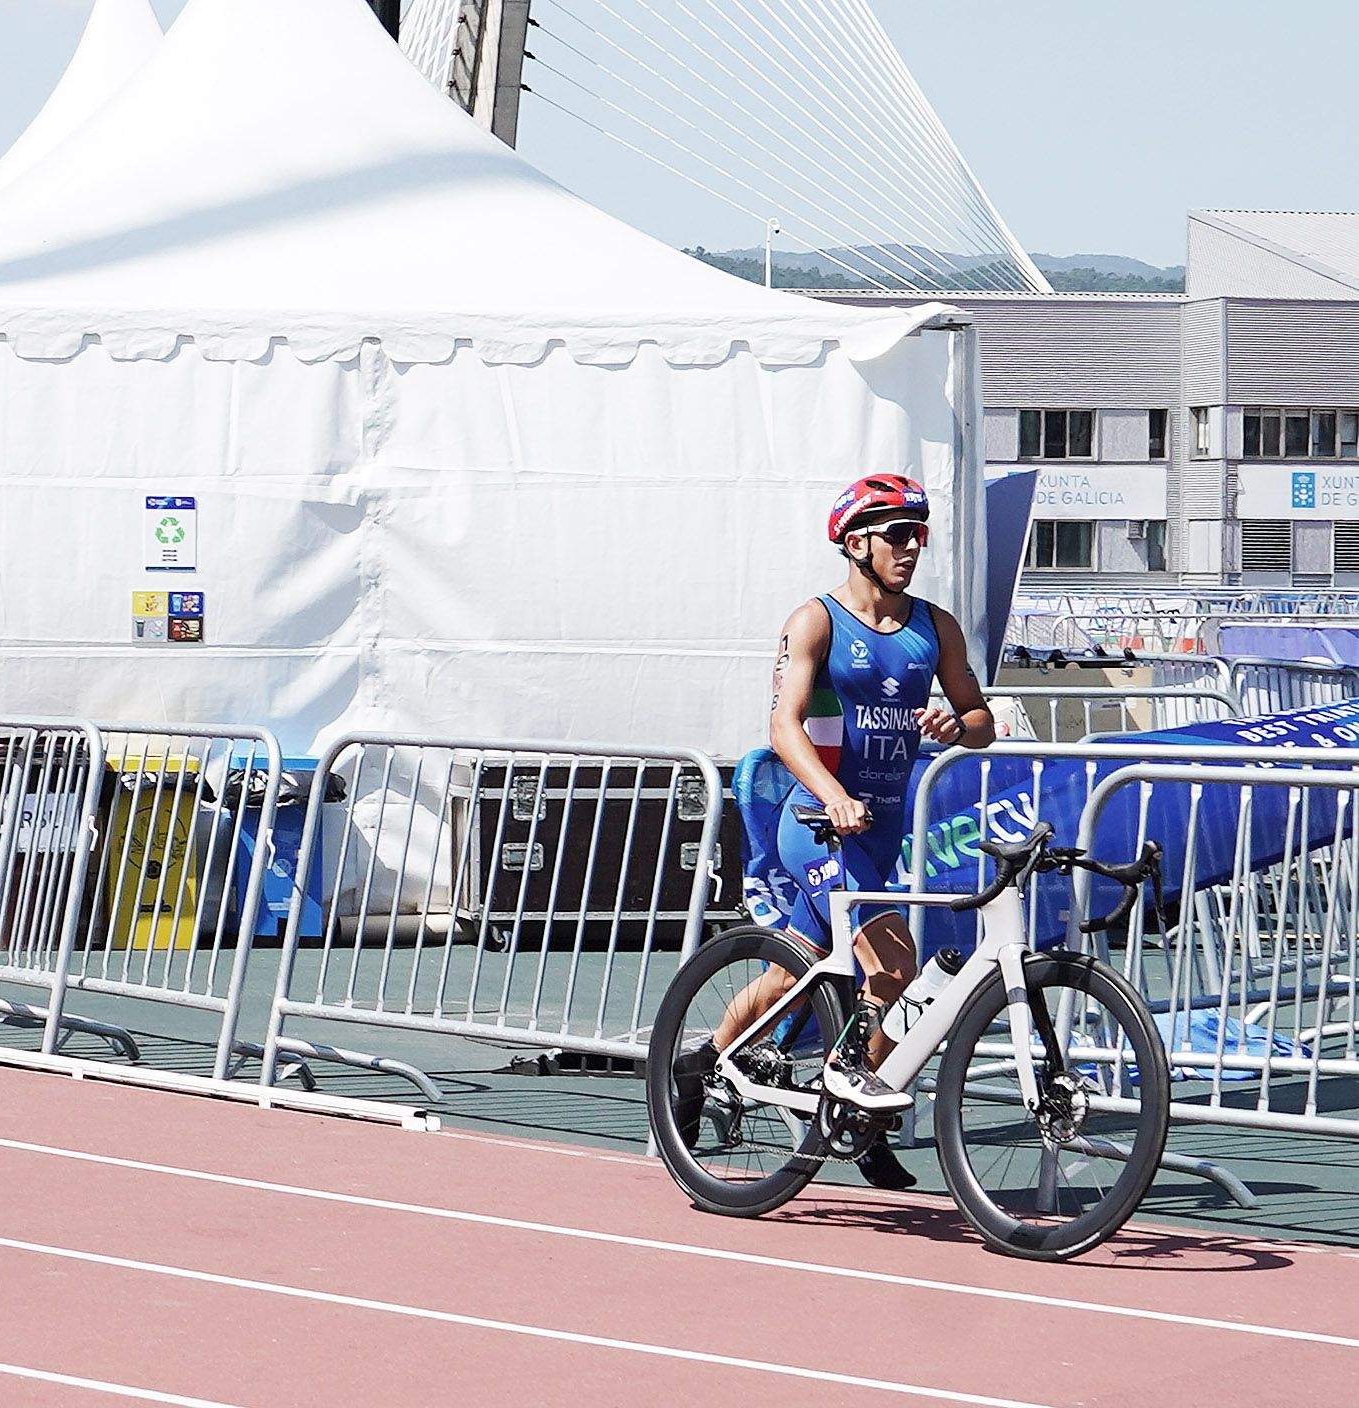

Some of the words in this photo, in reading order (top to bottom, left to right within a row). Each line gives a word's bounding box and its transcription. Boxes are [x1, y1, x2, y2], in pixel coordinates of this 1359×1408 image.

[1039, 475, 1091, 488] XUNTA
[1036, 491, 1056, 505] DE
[1061, 491, 1126, 505] GALICIA
[1322, 492, 1342, 506] DE
[1236, 720, 1299, 743] BEST
[863, 735, 907, 761] ITA
